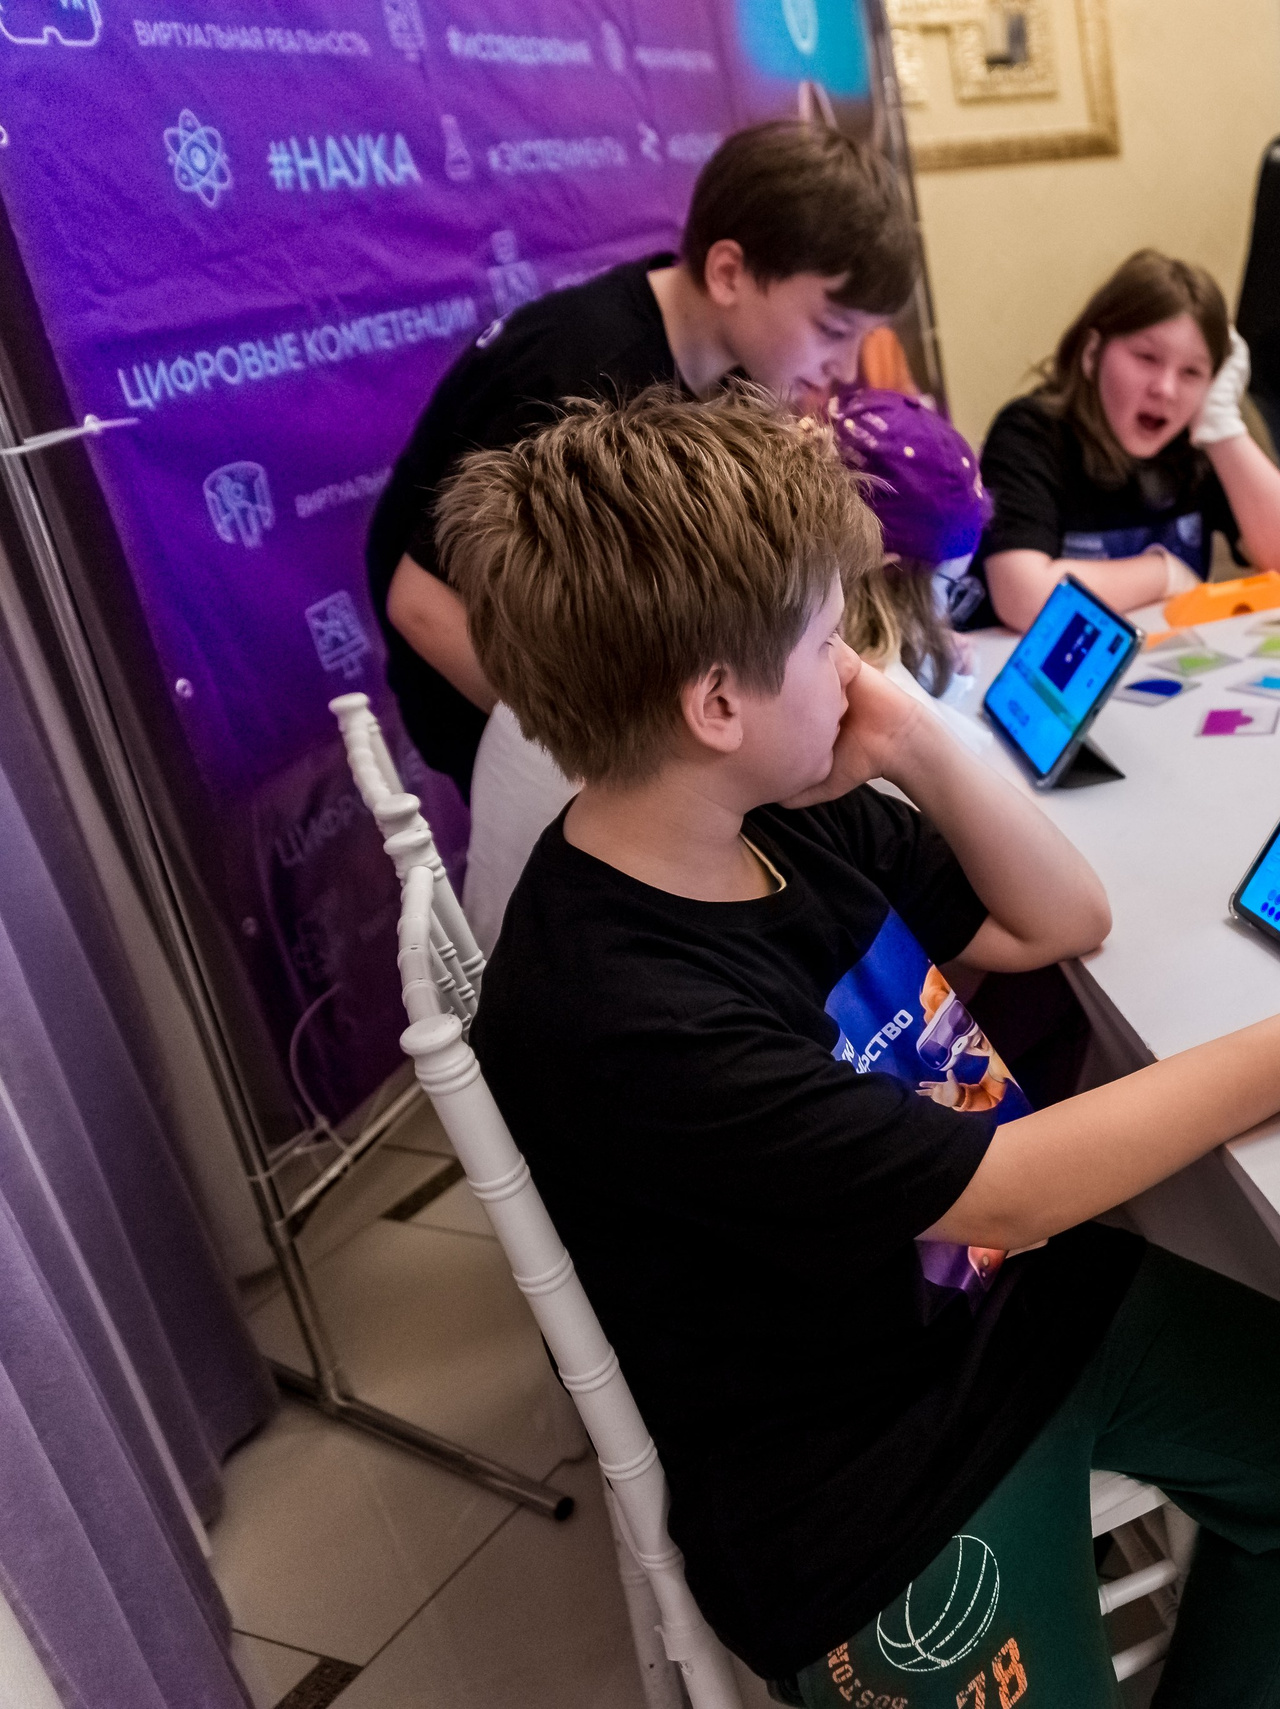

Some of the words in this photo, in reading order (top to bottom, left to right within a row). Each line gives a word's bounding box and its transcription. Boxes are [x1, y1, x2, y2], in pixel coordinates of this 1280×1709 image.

[267, 132, 423, 192] #НАУКА
[118, 332, 305, 411] ЦИФРОВЫЕ
[302, 298, 478, 366] КОМПЕТЕНЦИИ
